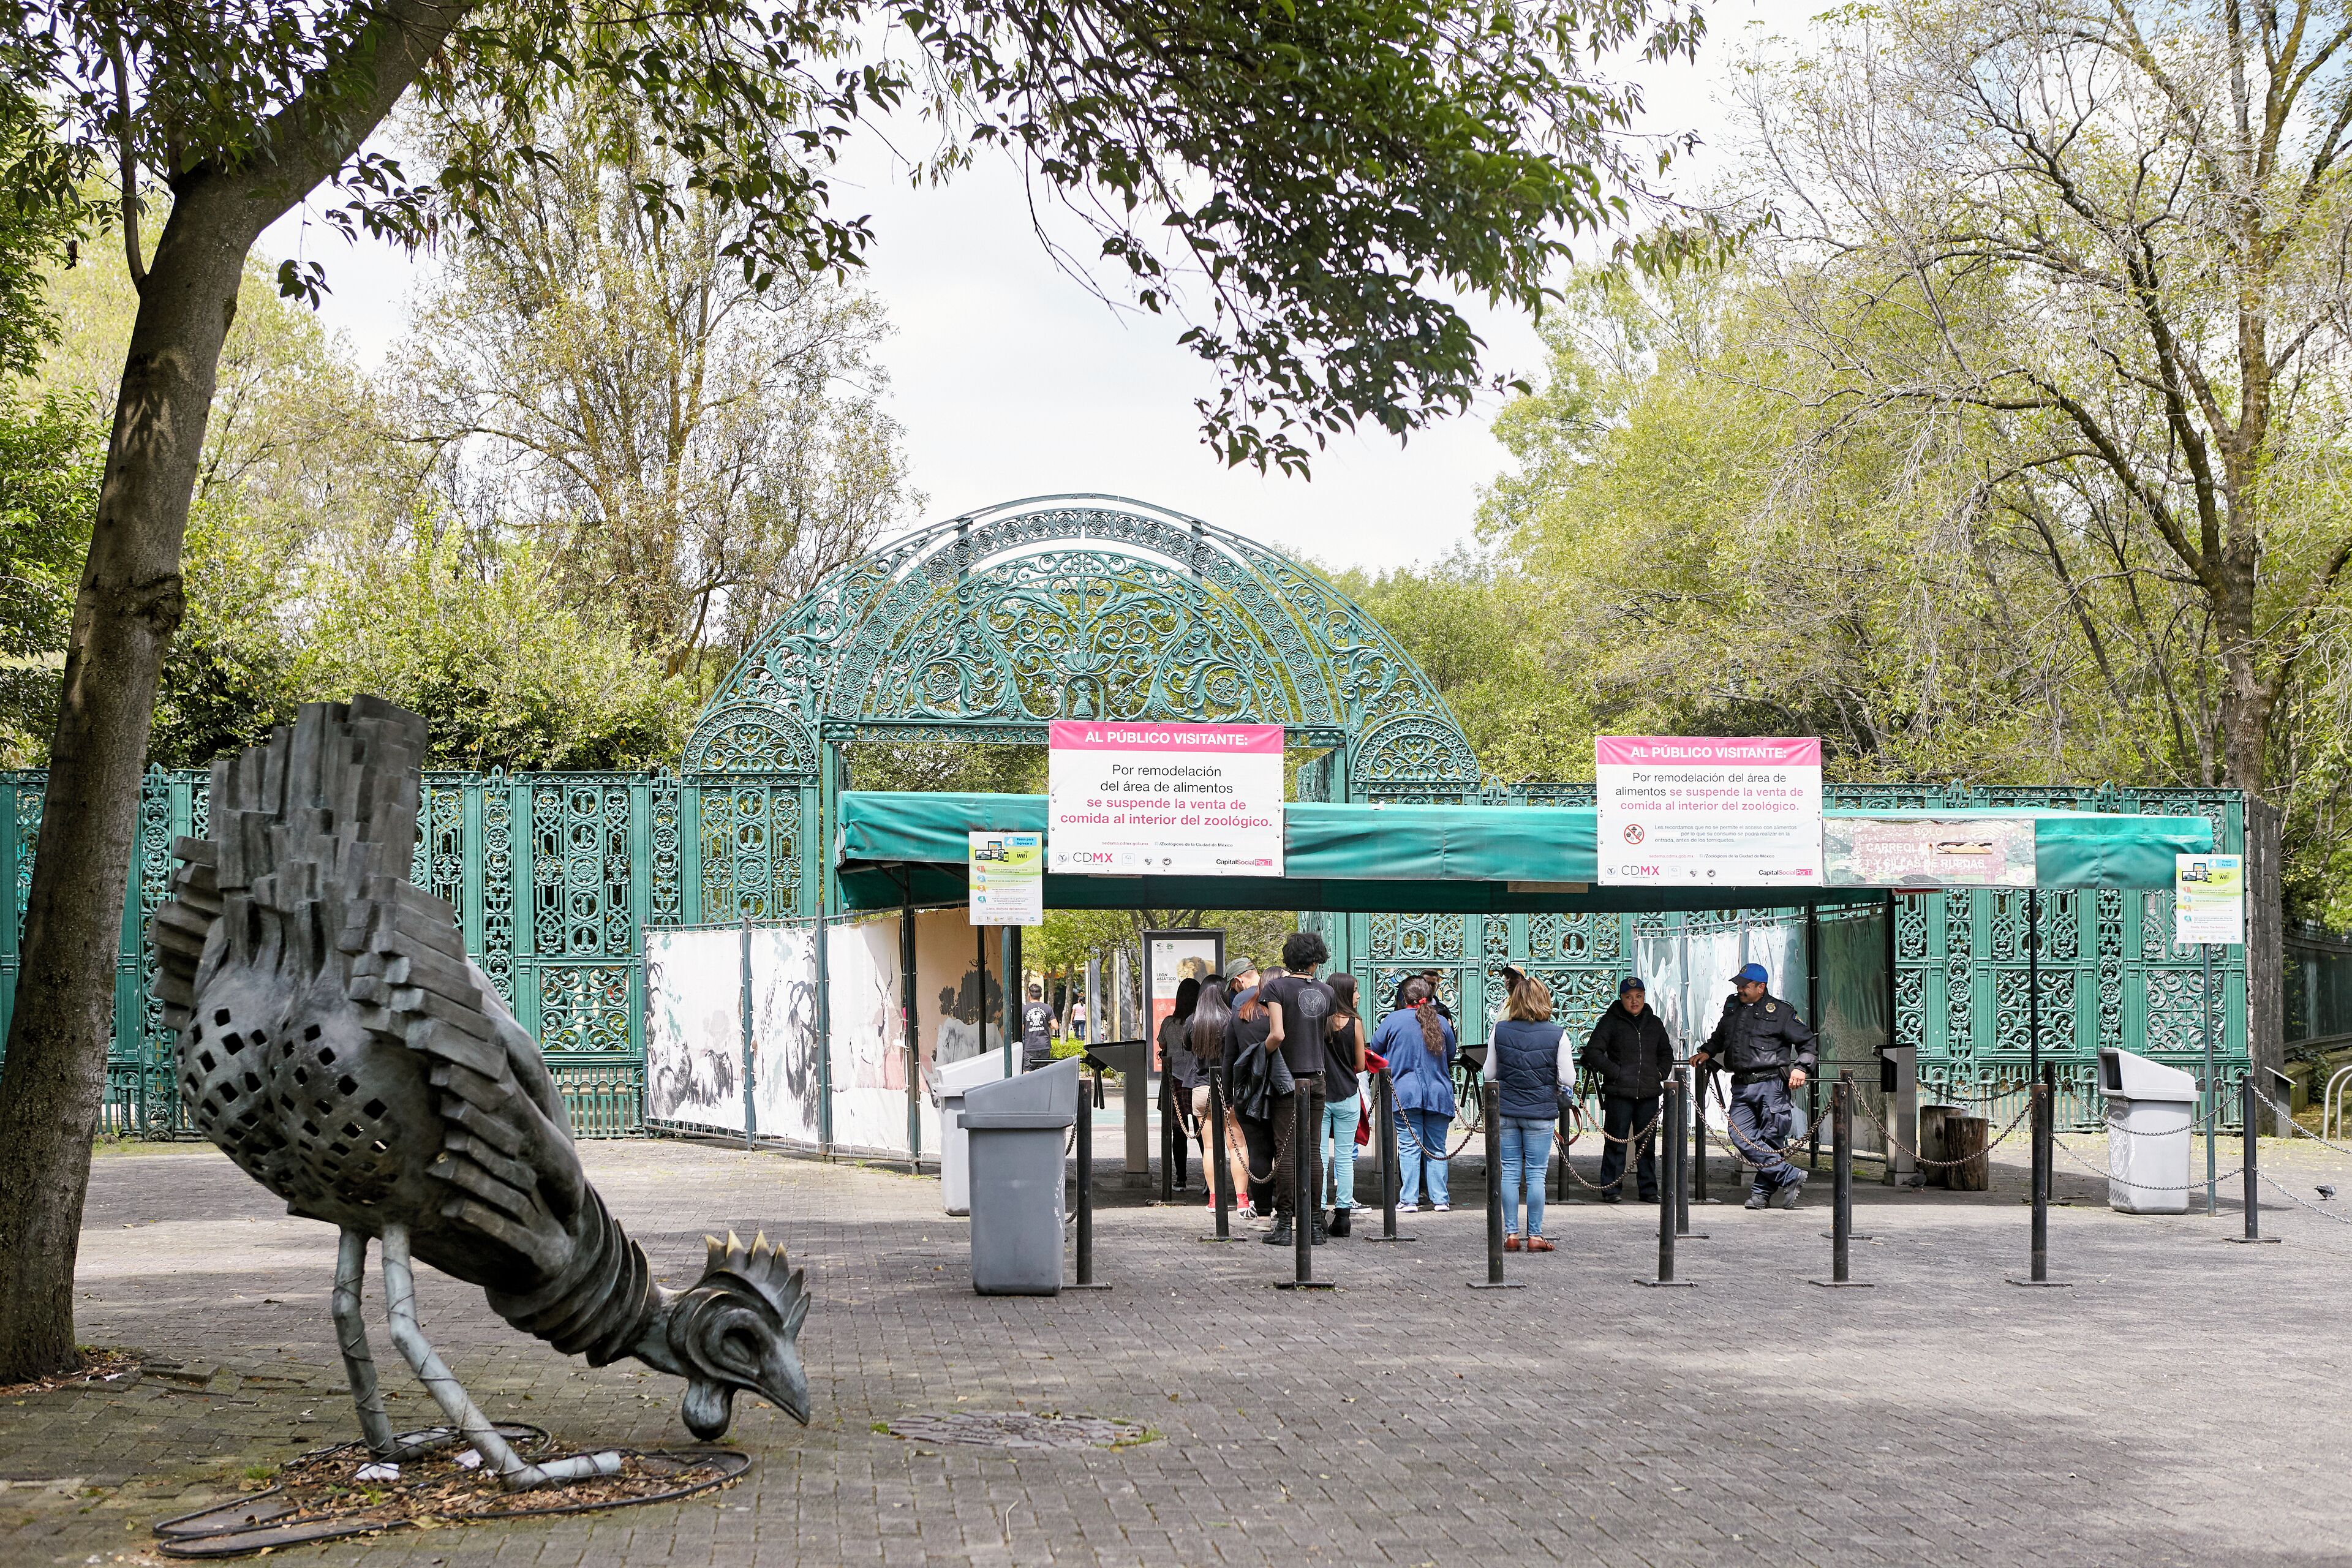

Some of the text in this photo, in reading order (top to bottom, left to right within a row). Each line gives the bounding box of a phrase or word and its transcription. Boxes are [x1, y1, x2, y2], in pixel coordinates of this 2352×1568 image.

[1085, 729, 1250, 745] AL PÚBLICO VISITANTE:
[1630, 744, 1787, 759] AL PÚBLICO VISITANTE:
[1113, 765, 1221, 776] Por remodelación
[1634, 773, 1651, 782] Por
[1728, 774, 1743, 782] del
[1747, 773, 1770, 782] área
[1773, 774, 1785, 782] de
[1101, 781, 1232, 793] del área de alimentos
[1616, 787, 1666, 796] alimentos
[1686, 788, 1740, 797] suspende
[1790, 788, 1803, 796] de
[1107, 798, 1170, 810] suspende
[1175, 799, 1185, 809] la
[1190, 800, 1225, 809] venta
[1231, 800, 1246, 810] de
[1621, 801, 1798, 812] comida al interior del zoológico.
[1061, 813, 1272, 828] comida al interior del zoológico.
[1913, 827, 1943, 836] SOLO
[1073, 853, 1113, 862] CDMX
[1621, 865, 1660, 875] CDMX
